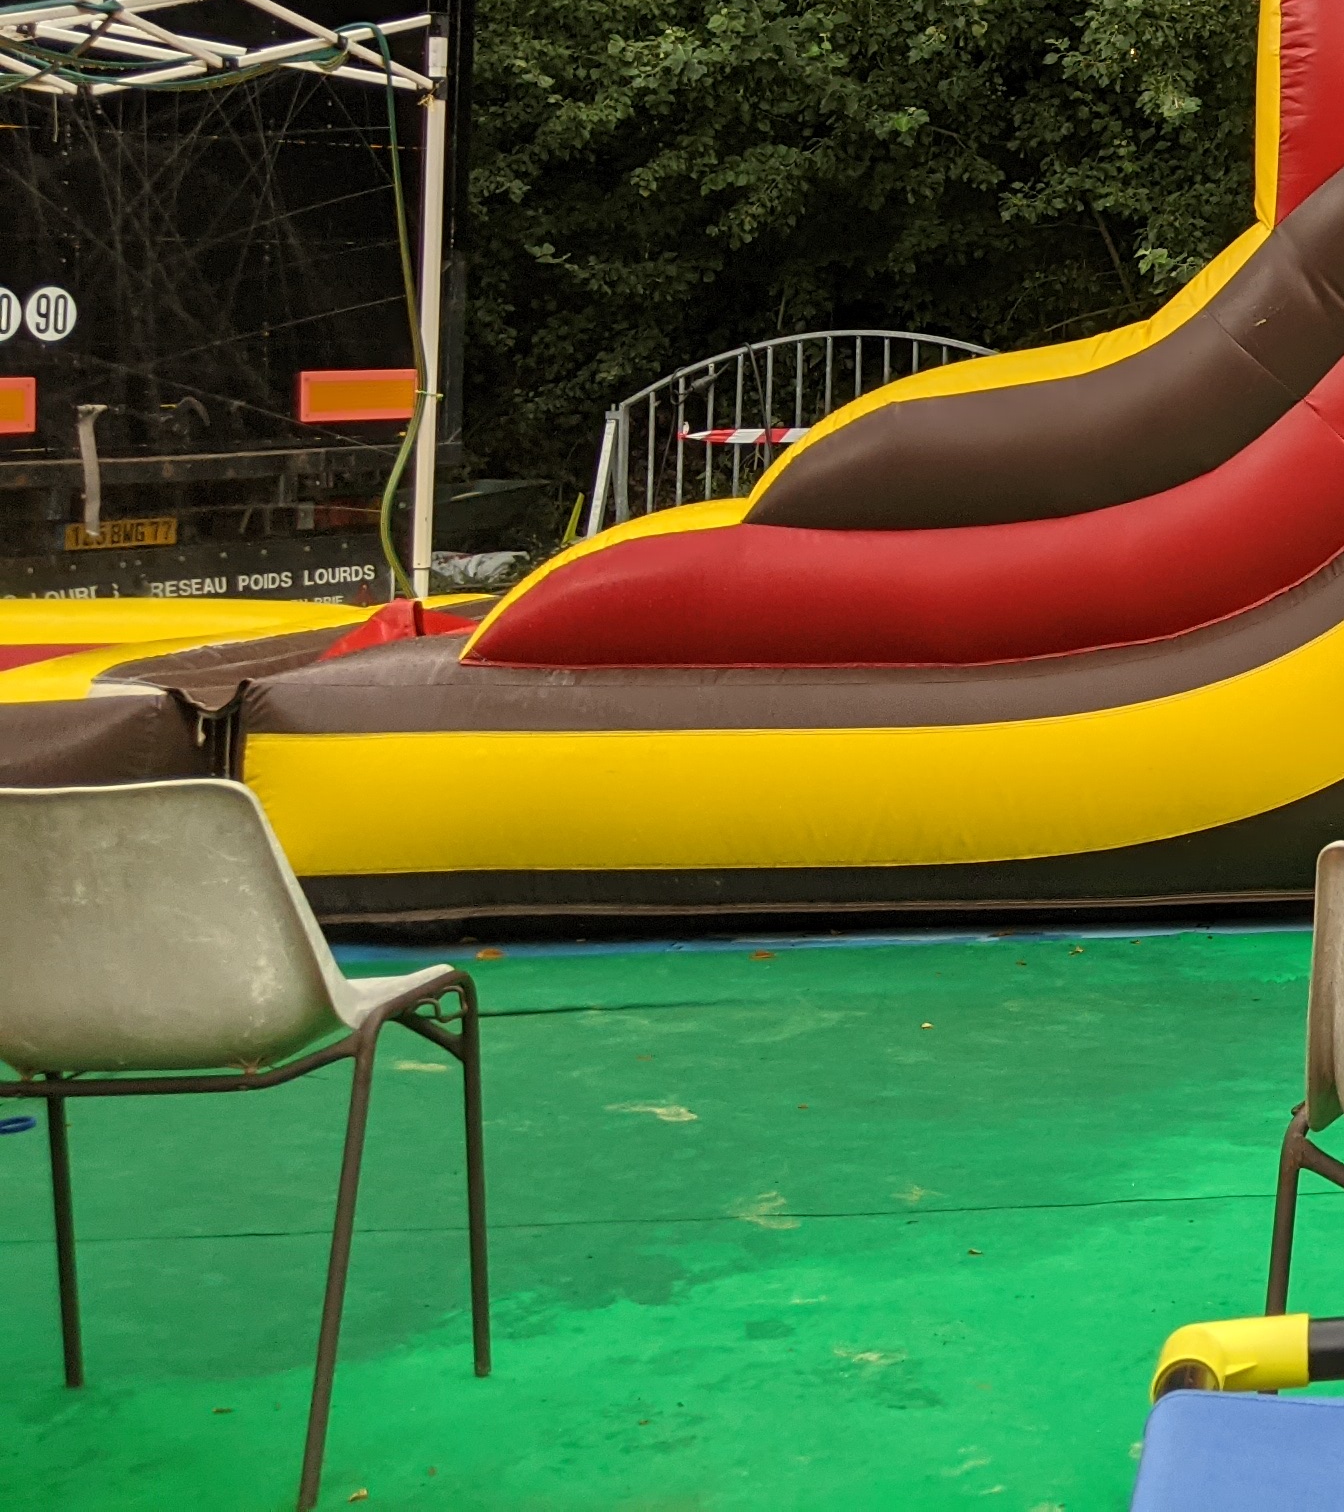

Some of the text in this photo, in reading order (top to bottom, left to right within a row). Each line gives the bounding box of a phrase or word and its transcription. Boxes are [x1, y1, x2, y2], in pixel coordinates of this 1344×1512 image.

[36, 293, 69, 335] 90
[150, 576, 227, 598] RESEAU
[238, 572, 293, 592] POIDS
[304, 565, 375, 586] LOURDS
